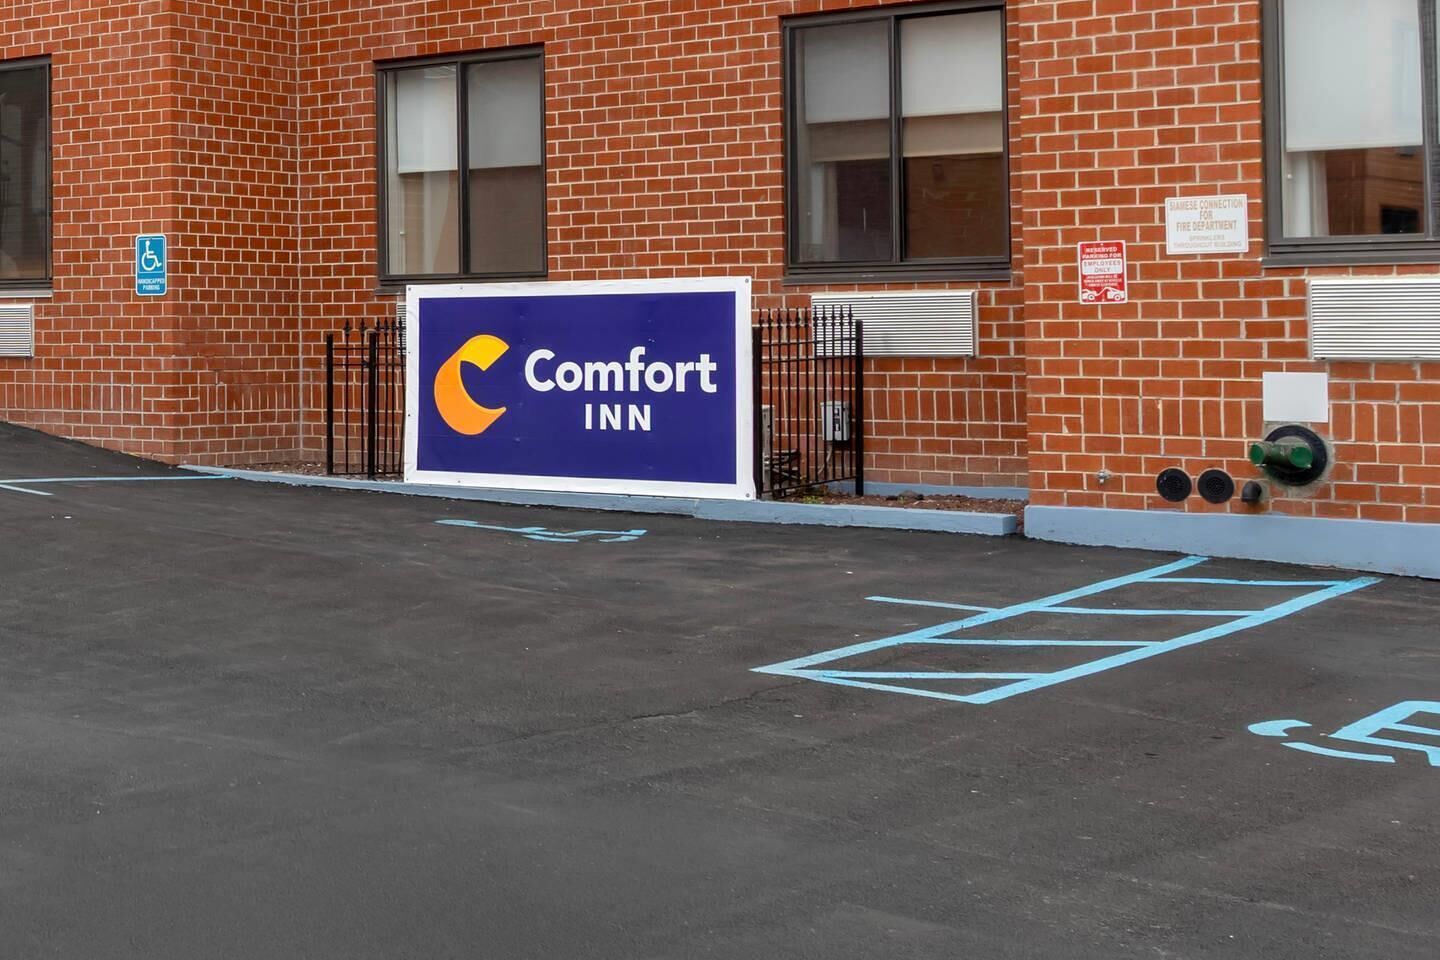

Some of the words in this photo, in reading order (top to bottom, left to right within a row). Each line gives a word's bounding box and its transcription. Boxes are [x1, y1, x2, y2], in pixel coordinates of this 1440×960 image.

[1170, 200, 1198, 211] SIAMESE
[1199, 199, 1244, 209] CONNECTION
[1199, 210, 1213, 220] FOR
[1176, 221, 1191, 232] FIRE
[1192, 220, 1237, 231] DEPARTMENT
[524, 345, 718, 394] Comfort
[584, 403, 651, 431] INN
